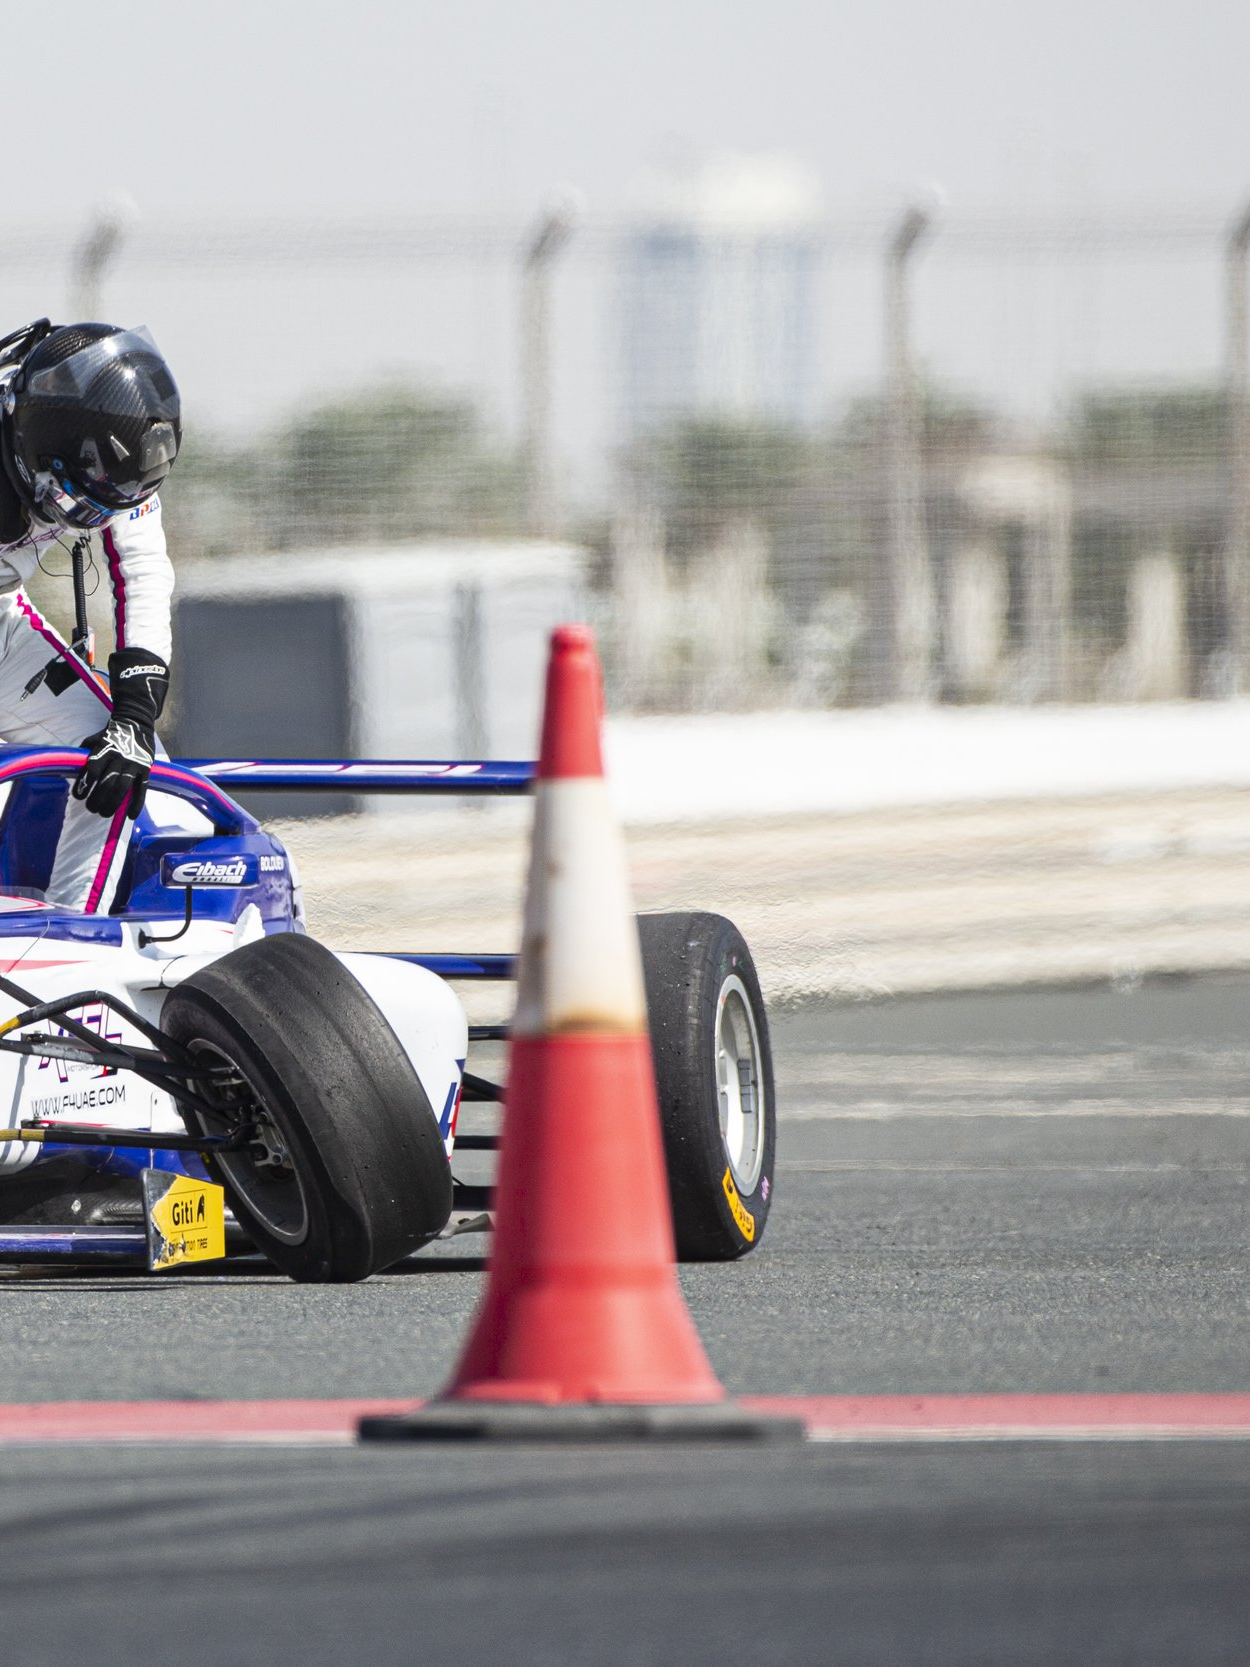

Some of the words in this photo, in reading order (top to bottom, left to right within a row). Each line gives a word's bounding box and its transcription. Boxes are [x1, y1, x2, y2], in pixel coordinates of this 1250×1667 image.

[172, 861, 247, 883] Eibach
[31, 1085, 127, 1117] WWW.F4UAE.COM
[172, 1200, 194, 1227] Giti
